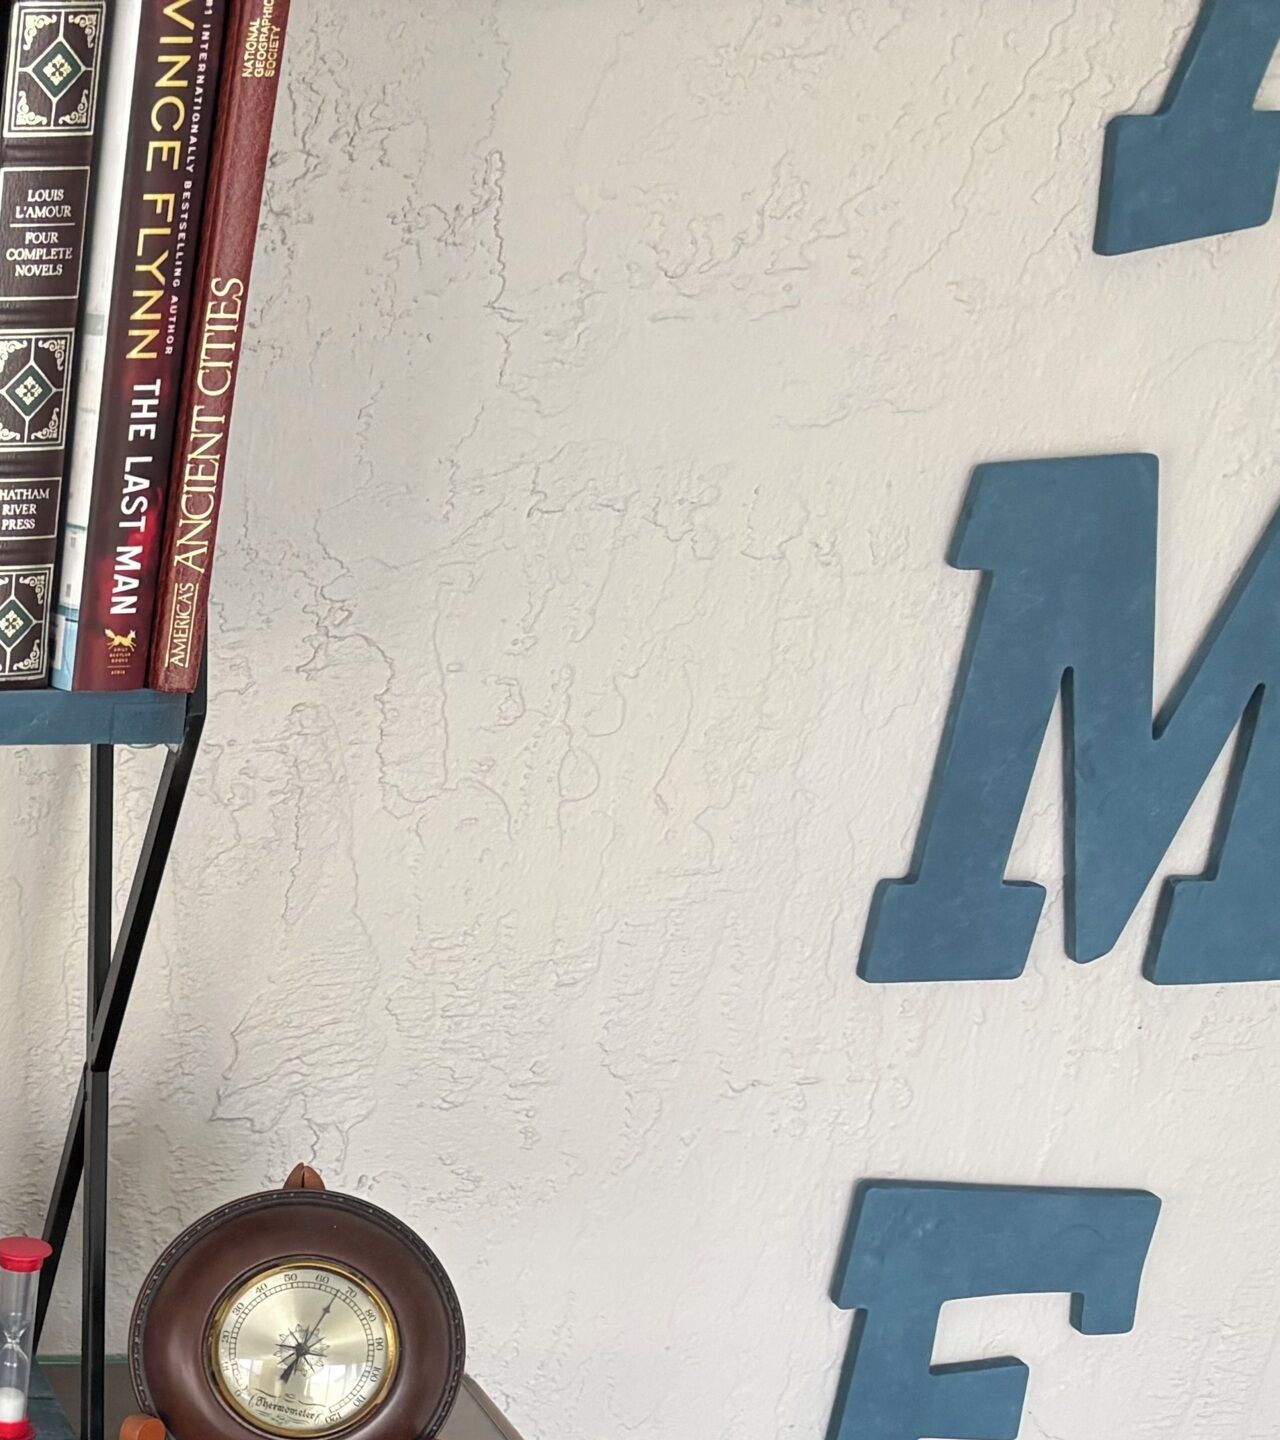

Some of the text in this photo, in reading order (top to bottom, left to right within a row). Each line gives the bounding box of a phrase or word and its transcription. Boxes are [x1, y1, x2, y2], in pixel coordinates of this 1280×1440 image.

[253, 0, 275, 78] GEOGRAPHIC
[242, 17, 261, 78] NATIONAL
[264, 25, 282, 78] SOCIETY
[125, 0, 196, 360] VINCE FLYNN
[27, 189, 64, 201] LOUIS
[15, 206, 71, 219] L'AMOUR
[25, 232, 59, 244] FOUR
[6, 248, 73, 261] COMPLETE
[15, 264, 63, 276] NOVELS
[128, 378, 161, 441] THE
[173, 276, 244, 574] ANCIENT CITIES
[118, 456, 153, 532] LAST
[2, 504, 37, 515] RIVER
[1, 518, 35, 531] PRESS
[110, 545, 143, 615] MAN
[168, 582, 195, 667] AMERICA'S
[284, 1273, 297, 1282] 50
[315, 1273, 329, 1284] 60
[255, 1283, 268, 1294] 40
[346, 1286, 358, 1298] 70
[365, 1309, 377, 1323] 80
[256, 1396, 314, 1420] Thermometer
